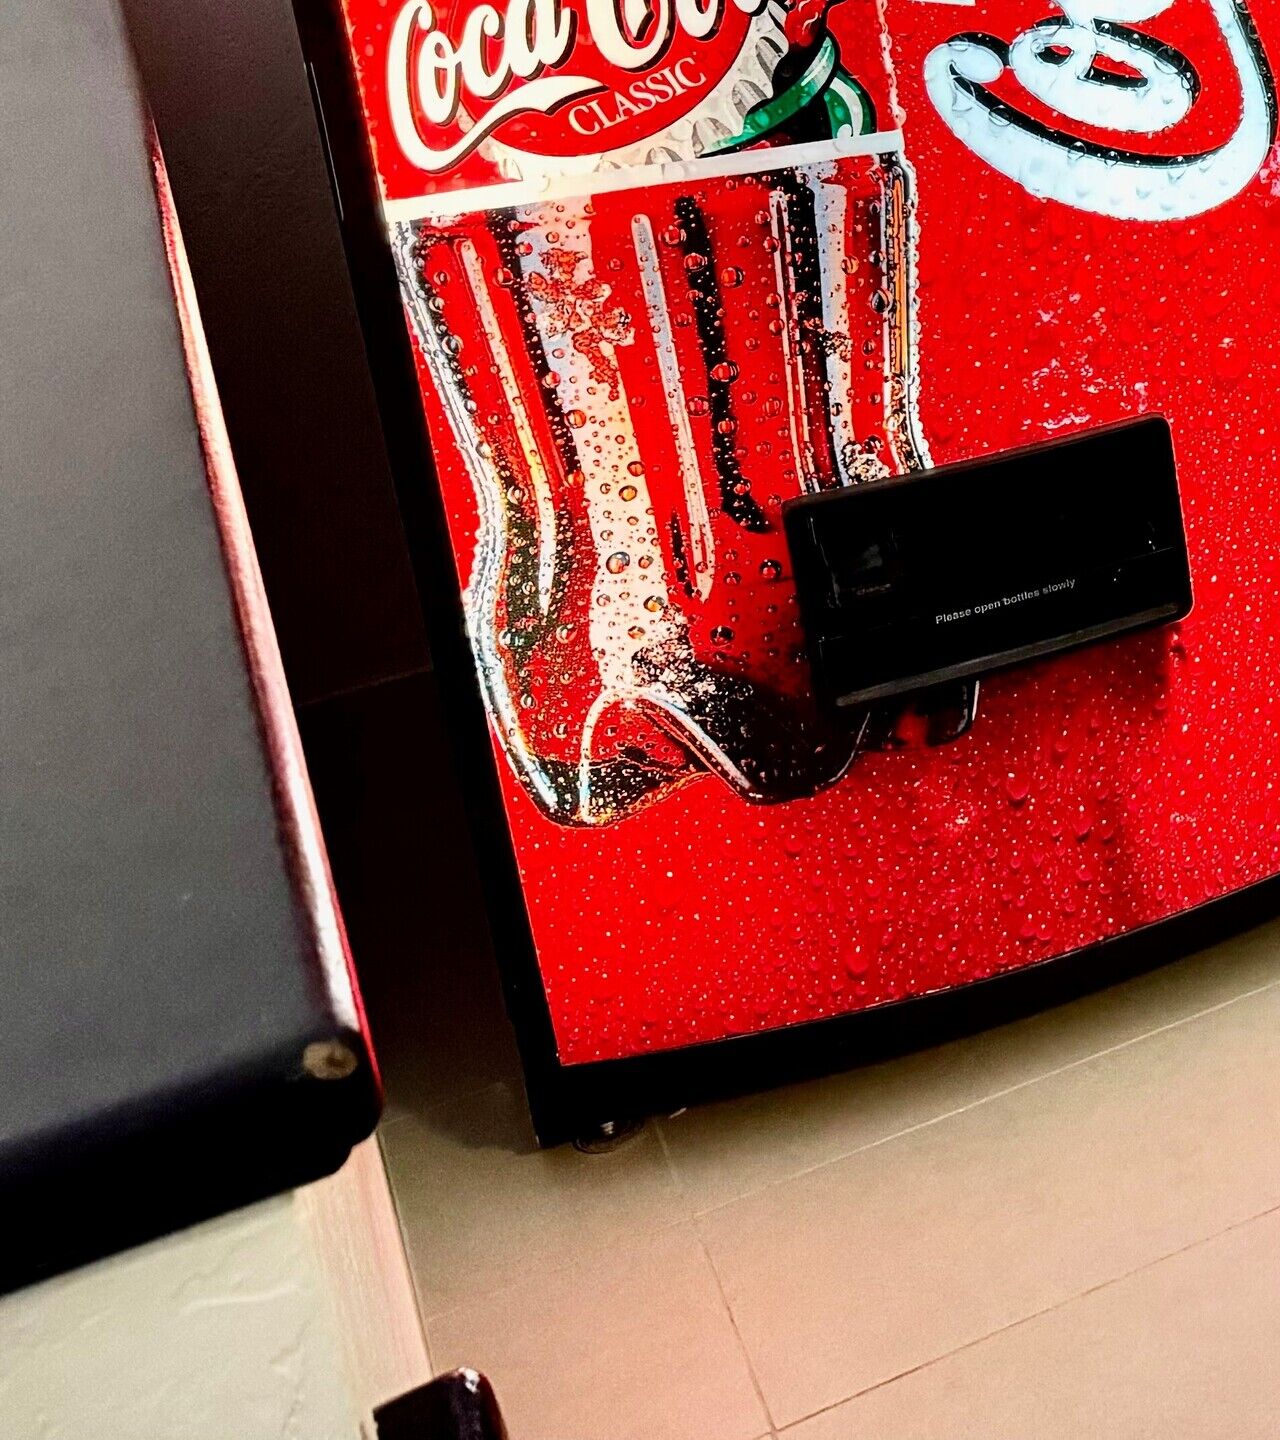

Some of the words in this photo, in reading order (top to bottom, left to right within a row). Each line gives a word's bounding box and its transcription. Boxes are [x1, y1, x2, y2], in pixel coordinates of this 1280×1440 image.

[566, 56, 708, 137] CLASSIC
[935, 608, 972, 624] Please
[974, 600, 1001, 614] open
[1002, 588, 1040, 606] bottles
[1042, 578, 1076, 594] slowly
